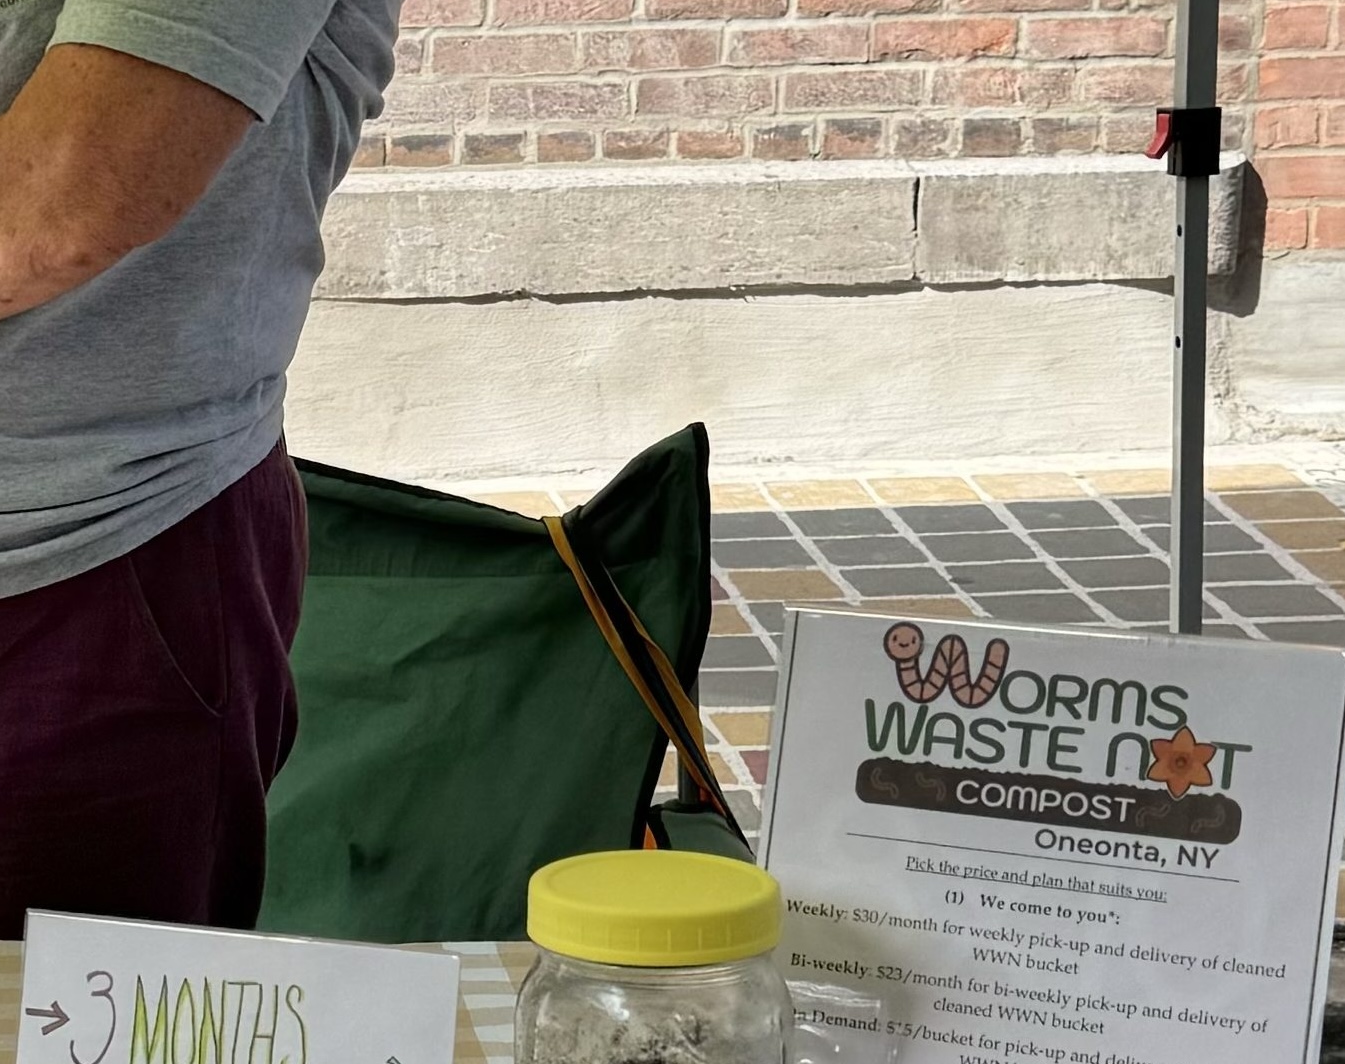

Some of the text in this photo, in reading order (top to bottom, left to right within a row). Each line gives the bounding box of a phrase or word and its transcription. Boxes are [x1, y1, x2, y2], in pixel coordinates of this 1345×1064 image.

[864, 698, 1083, 775] WASTE
[956, 778, 1137, 825] COMPOST
[1034, 828, 1220, 869] Oneonta, NY
[906, 855, 1168, 903] Pick the price and plan that suits you:
[945, 890, 965, 906] (1)
[980, 893, 1005, 910] We
[1009, 901, 1052, 916] come
[1057, 905, 1072, 918] to
[787, 899, 1287, 979] Weekly: $30/month for weekly pick-up and delivery of cleaned
[972, 948, 1079, 975] WWN bucket
[70, 970, 308, 1064] 3 MONTHS
[790, 953, 1269, 1034] Bi-weekly: $23/month for bi-weekly pick-up and delivery of
[933, 998, 1105, 1034] cleaned WWN bucket
[812, 1010, 881, 1032] Demand:
[978, 1033, 1001, 1051] for
[1005, 1040, 1066, 1063] pick-up
[1070, 1049, 1100, 1064] and
